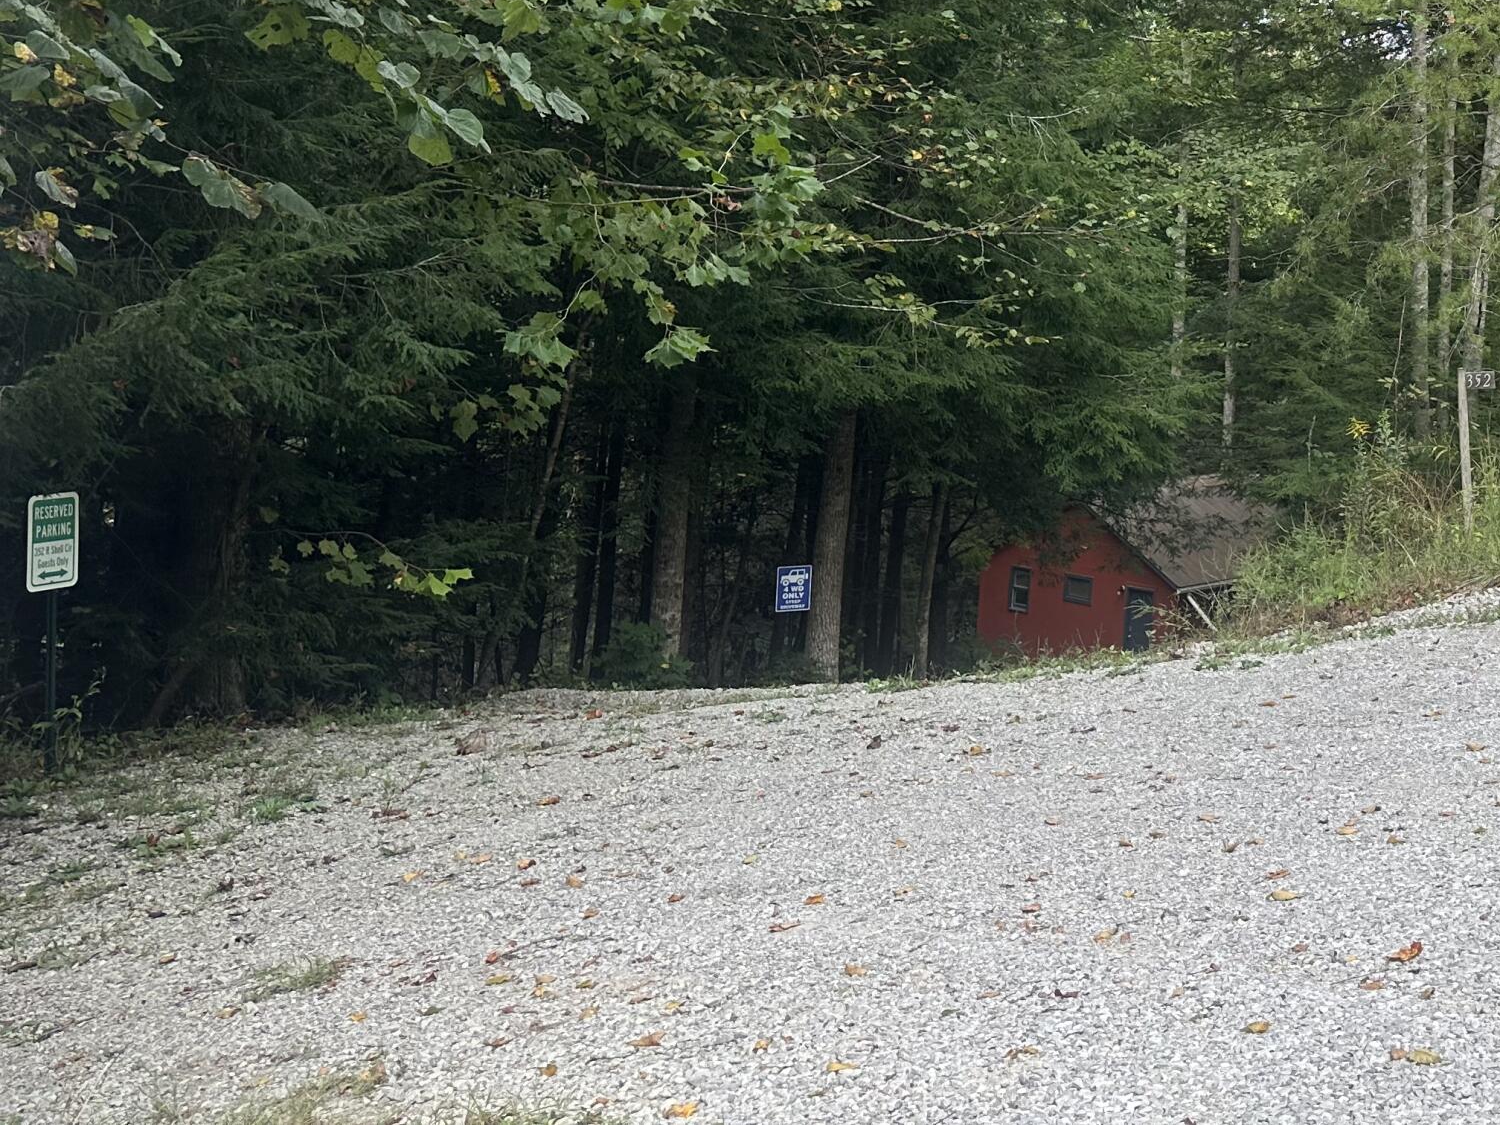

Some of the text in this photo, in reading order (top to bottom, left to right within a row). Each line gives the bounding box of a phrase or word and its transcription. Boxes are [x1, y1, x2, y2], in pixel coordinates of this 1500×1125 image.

[1466, 373, 1491, 388] 352
[34, 503, 74, 520] RESERVED
[35, 522, 72, 538] PARKING
[37, 556, 69, 569] Guests Only
